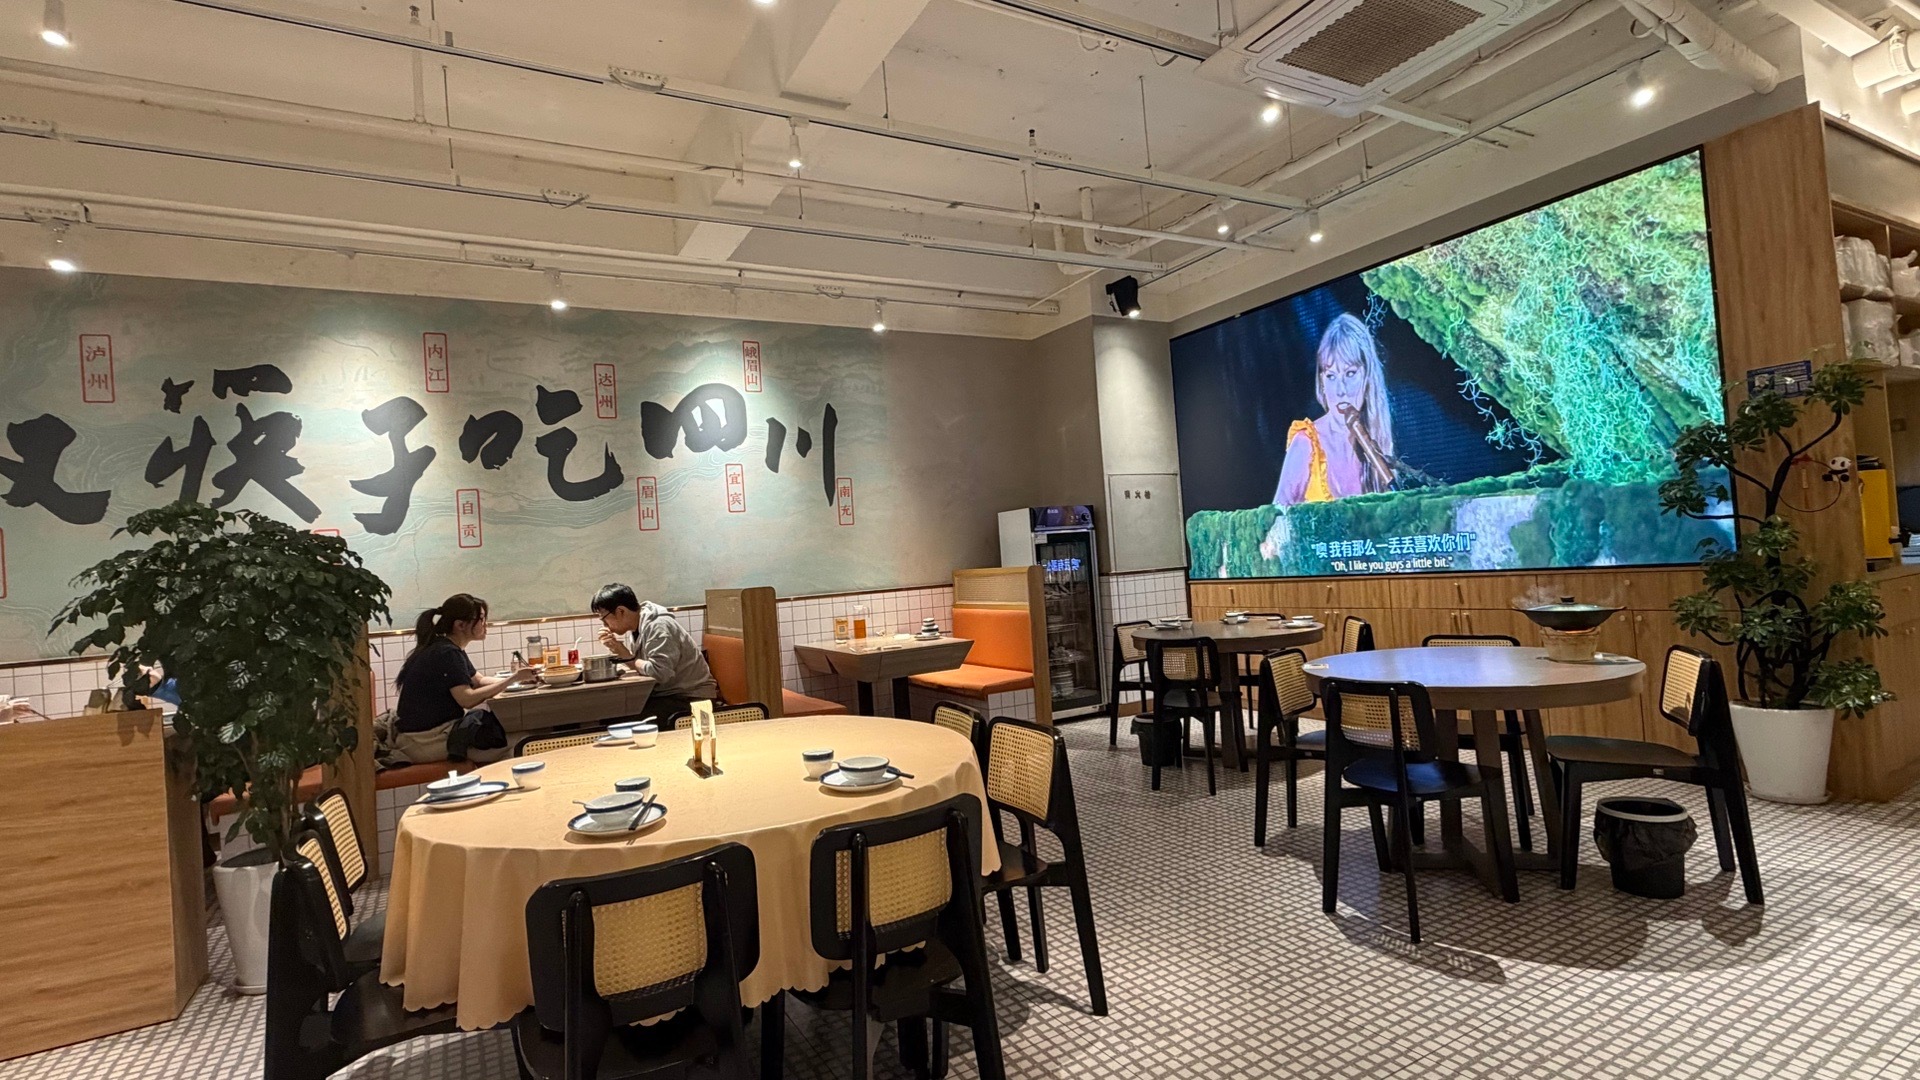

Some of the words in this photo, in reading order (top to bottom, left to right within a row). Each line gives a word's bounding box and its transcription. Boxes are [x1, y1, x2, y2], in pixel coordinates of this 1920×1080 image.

[85, 345, 108, 391] 泸州
[427, 343, 446, 383] 内江
[744, 346, 758, 386] 峨眉山
[597, 373, 613, 410] 达州
[641, 484, 655, 520] 眉山
[728, 471, 743, 507] 宜宾
[839, 485, 852, 516] 南充
[461, 500, 477, 539] 自贡
[1353, 560, 1368, 571] like
[1369, 561, 1384, 572] you
[1384, 559, 1404, 572] guys
[1405, 559, 1412, 569] a
[1412, 556, 1433, 568] little
